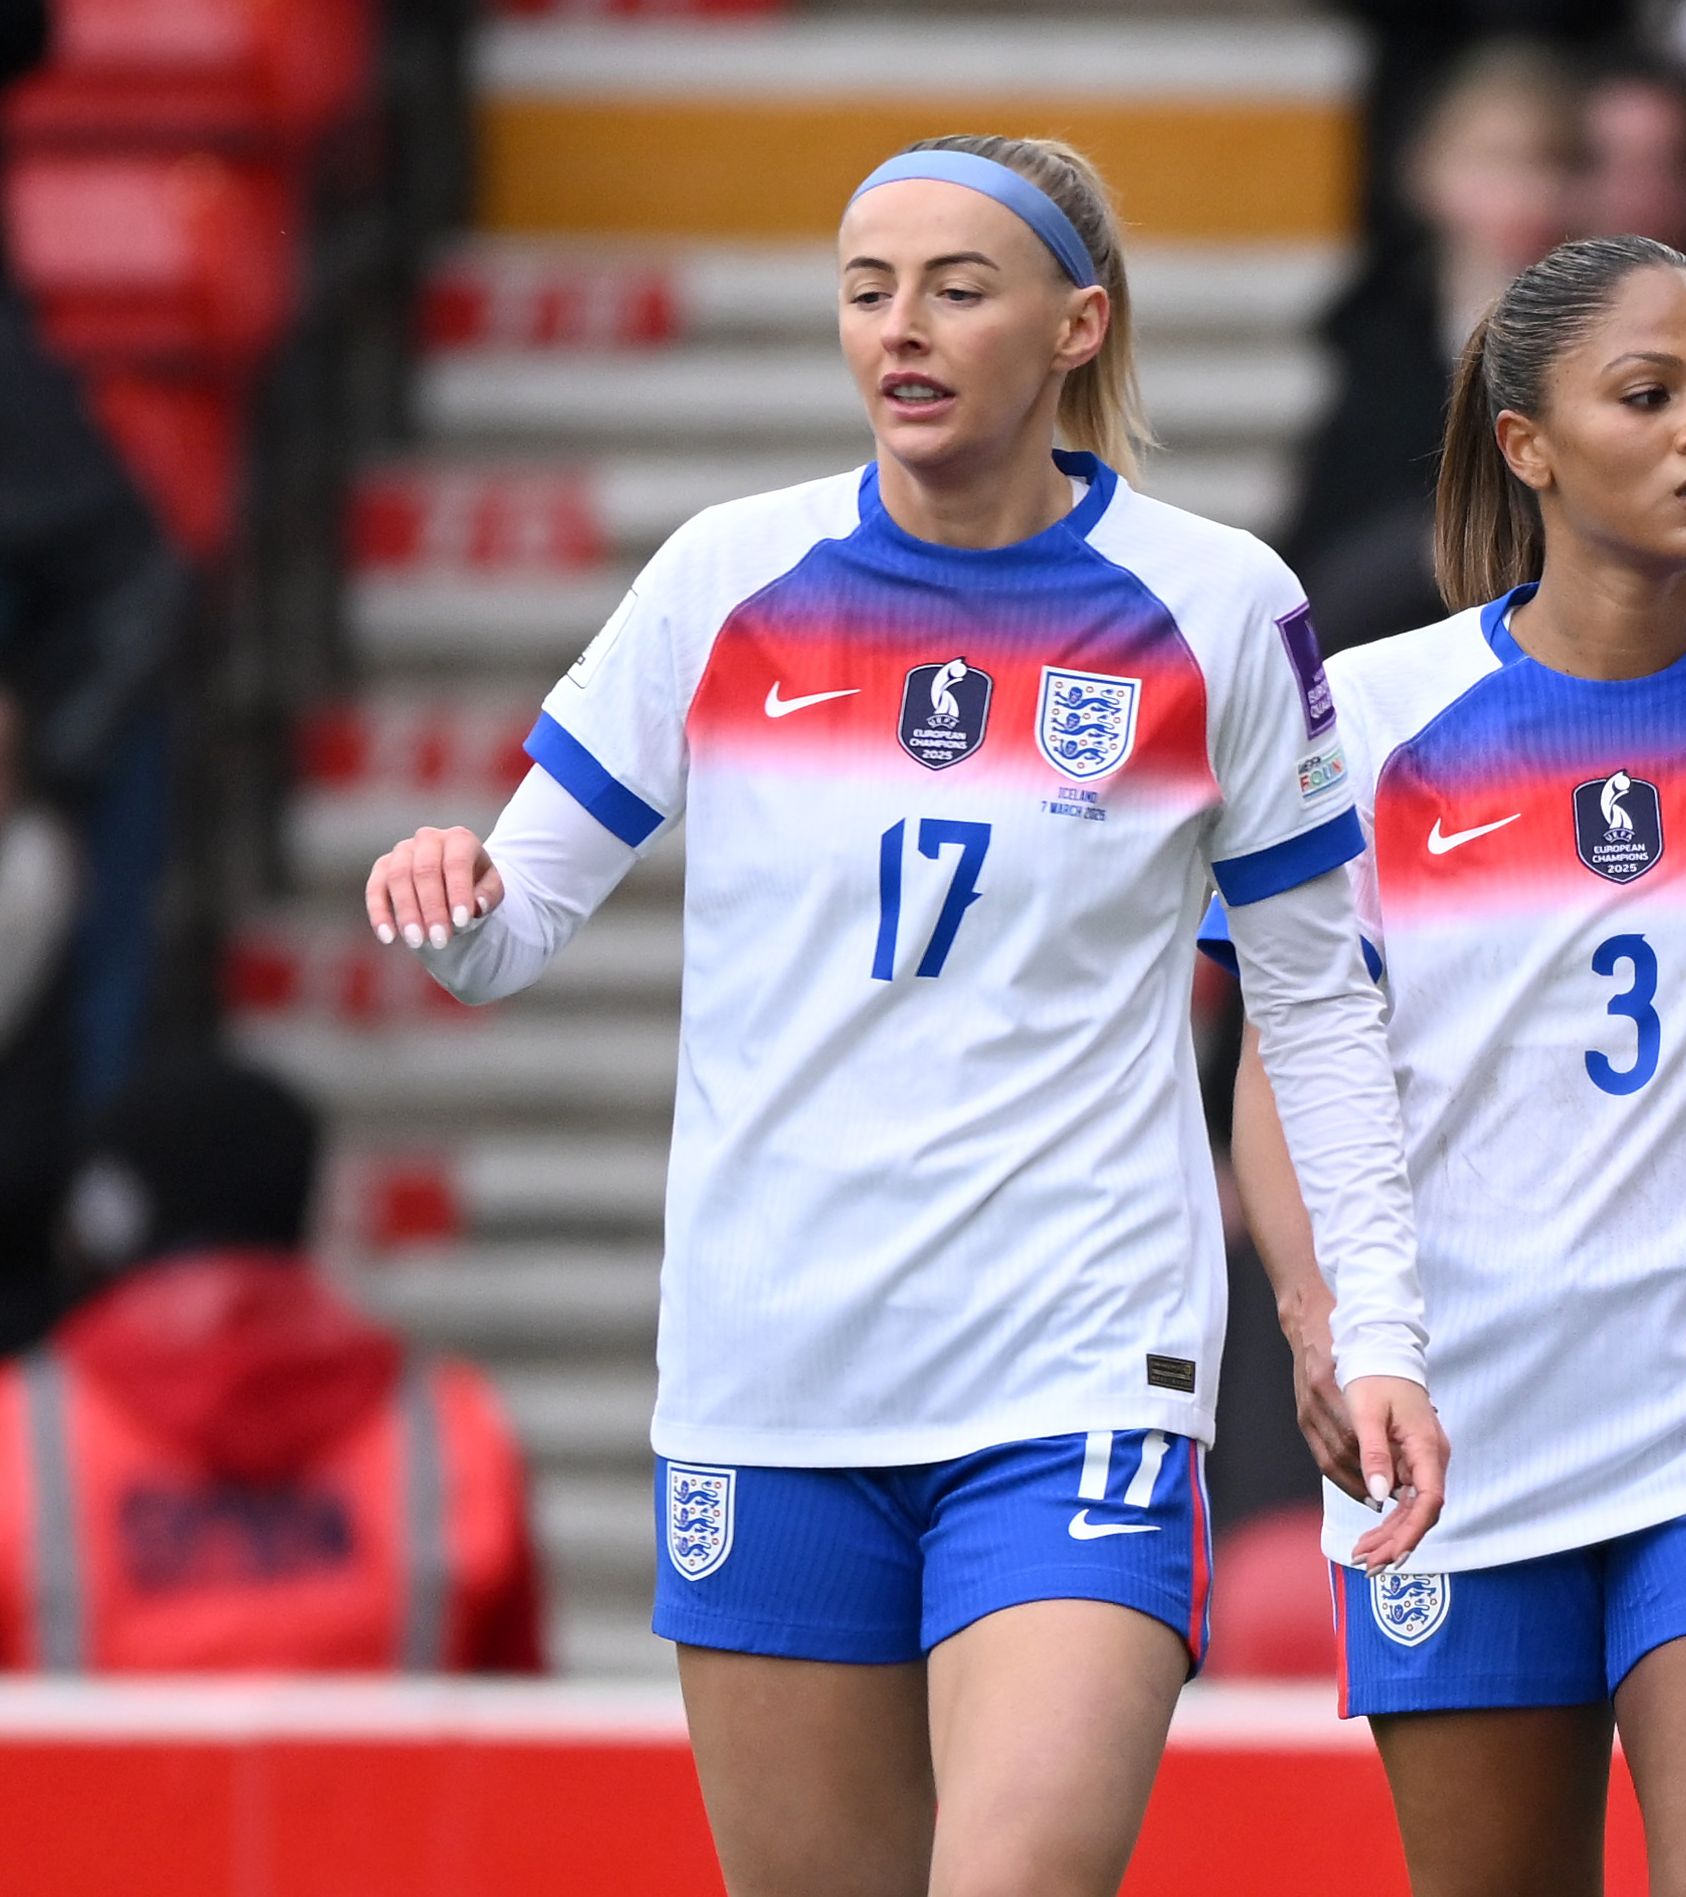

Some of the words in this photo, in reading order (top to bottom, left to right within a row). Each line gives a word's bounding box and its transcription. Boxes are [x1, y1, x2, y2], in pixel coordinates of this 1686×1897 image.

[913, 729, 967, 740] EUROPEAN
[909, 738, 968, 749] CHAMPIONS
[922, 749, 953, 760] 2025
[1058, 787, 1098, 803] ICELAND
[1041, 800, 1048, 813] 7
[1050, 802, 1083, 817] MARCH
[1593, 844, 1646, 854] EUROPEAN
[1592, 852, 1649, 863] CHAMPIONS
[1607, 863, 1637, 873] 2025
[871, 817, 992, 981] 17
[1585, 933, 1661, 1096] 3
